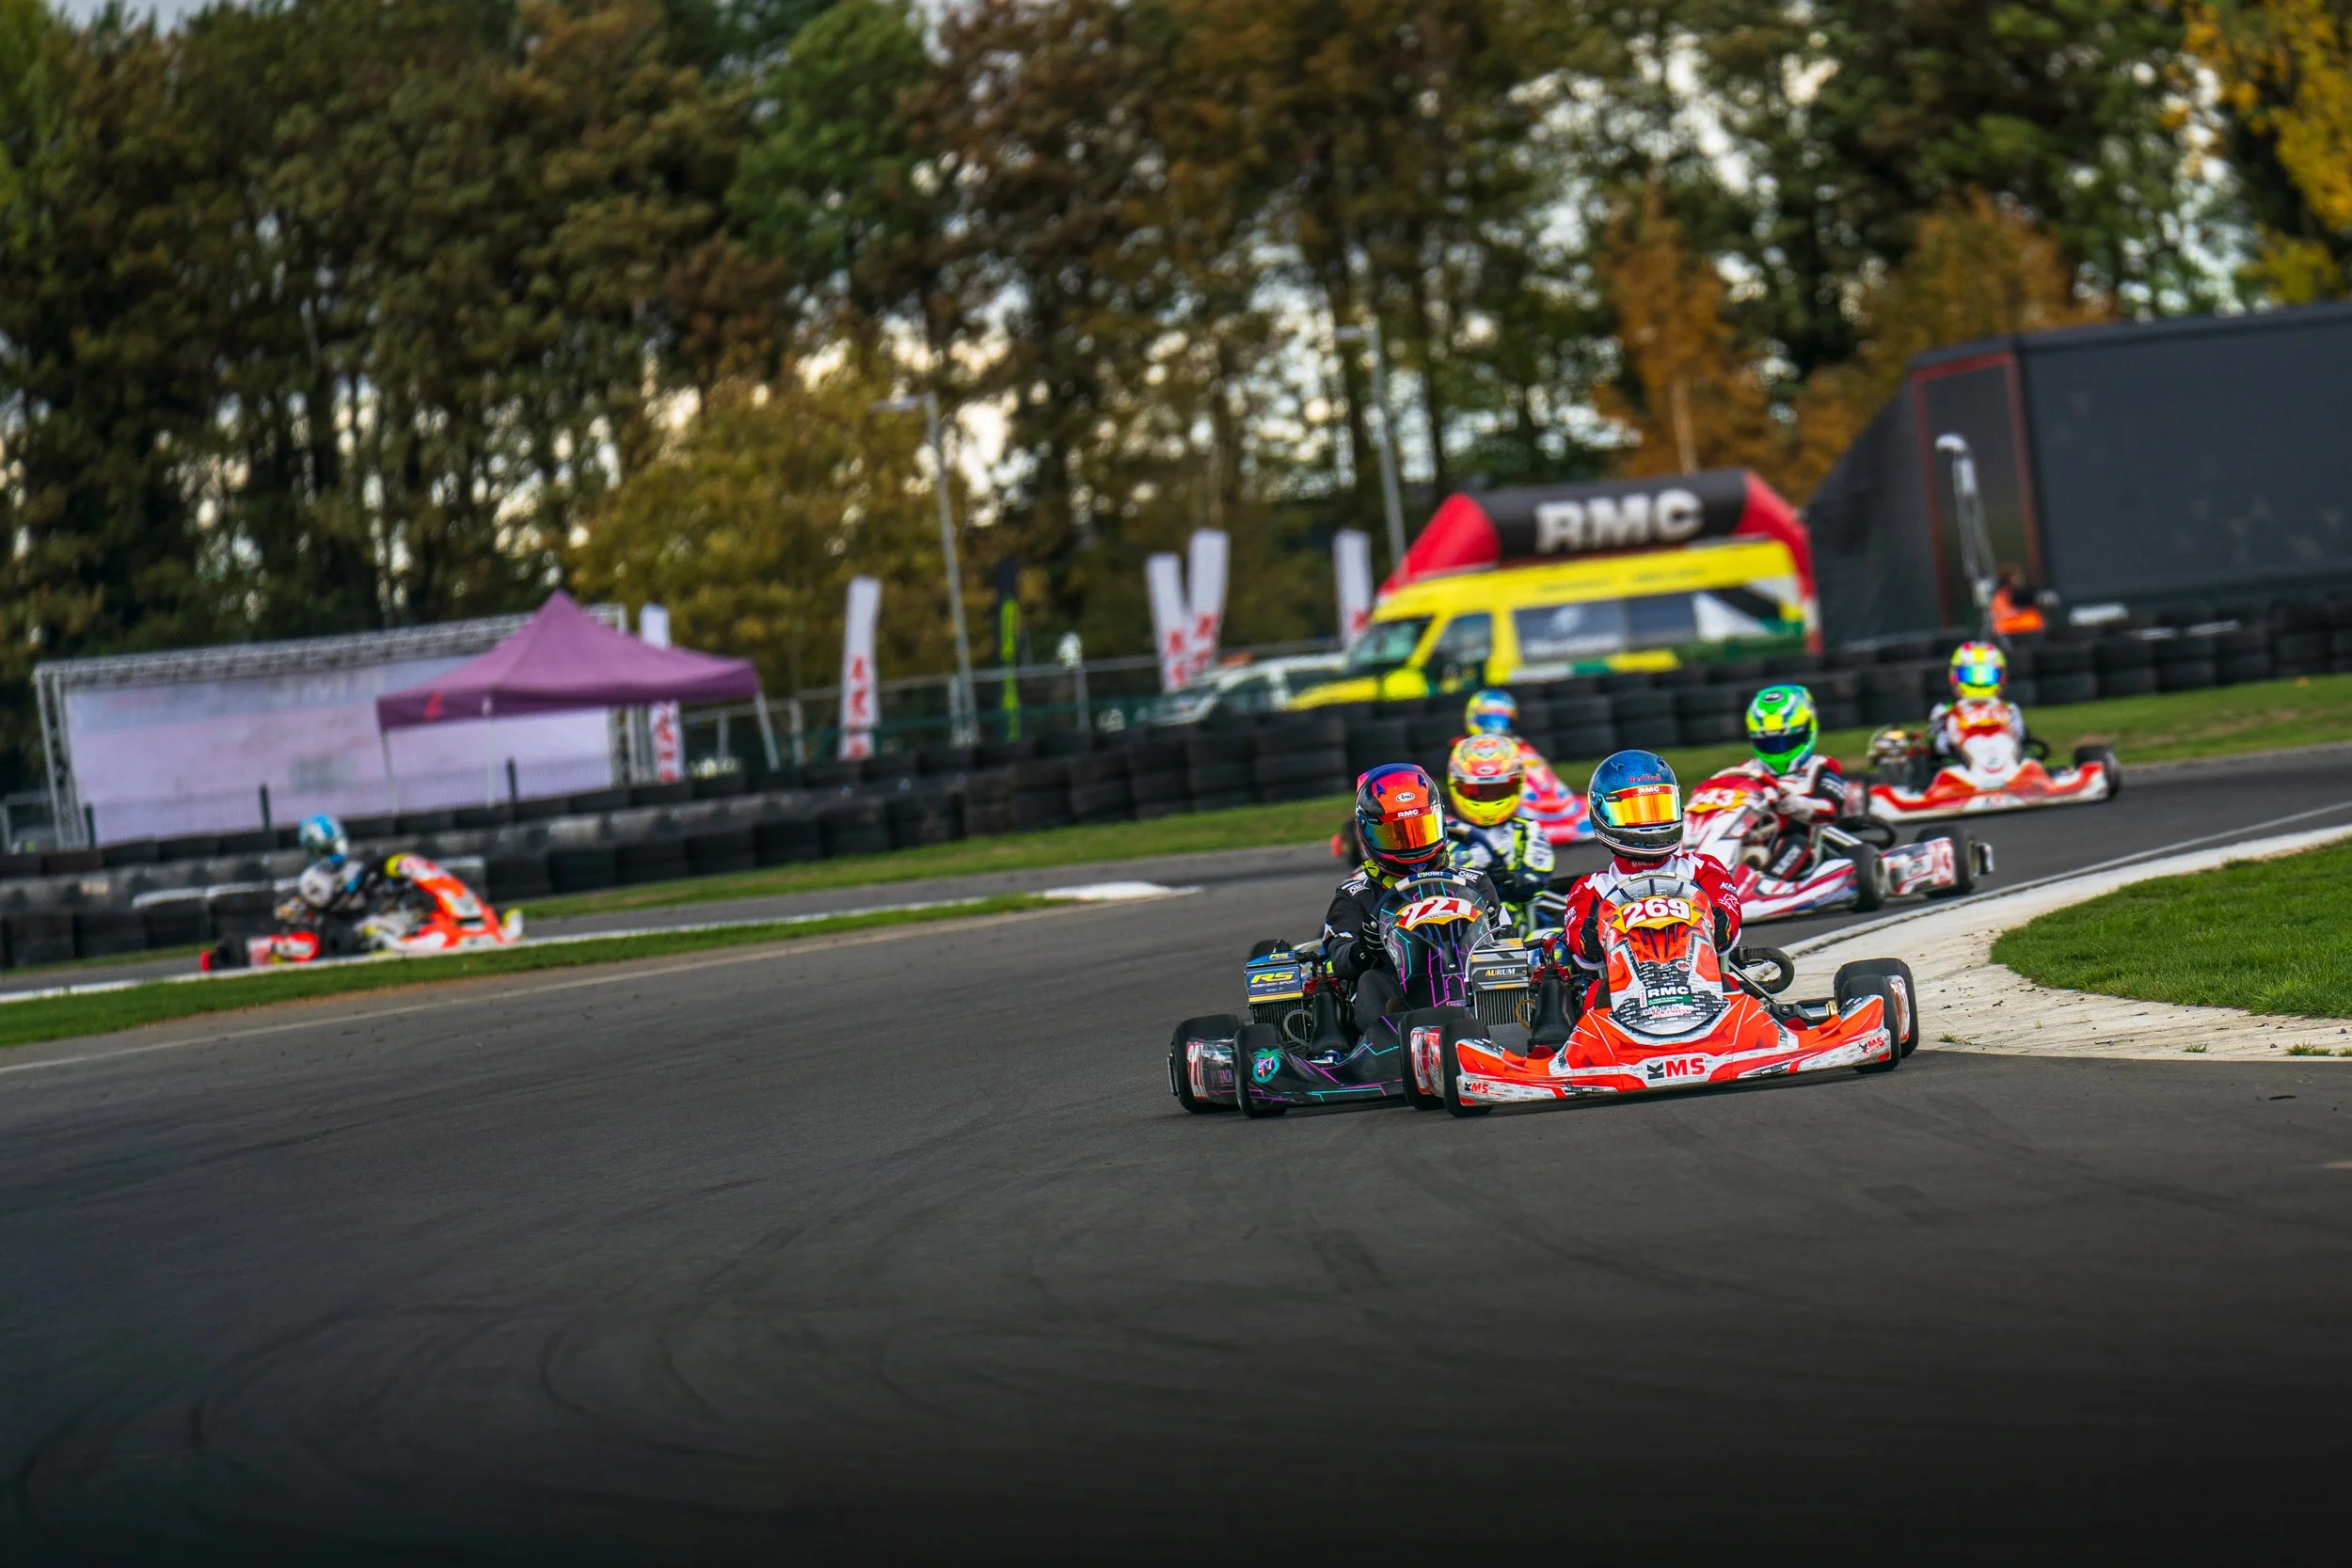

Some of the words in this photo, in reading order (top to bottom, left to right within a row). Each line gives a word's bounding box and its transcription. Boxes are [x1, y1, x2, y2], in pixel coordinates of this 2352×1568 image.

[1534, 488, 1705, 554] RMC
[1638, 785, 1660, 794] RMC
[1397, 809, 1419, 818] RMC
[1458, 870, 1480, 882] OMP
[1623, 898, 1691, 928] 269
[1250, 971, 1295, 984] RS
[1485, 968, 1516, 977] AURUM
[1647, 986, 1690, 998] RMC
[1647, 1057, 1706, 1080] KMS
[1464, 1082, 1489, 1094] KMS
